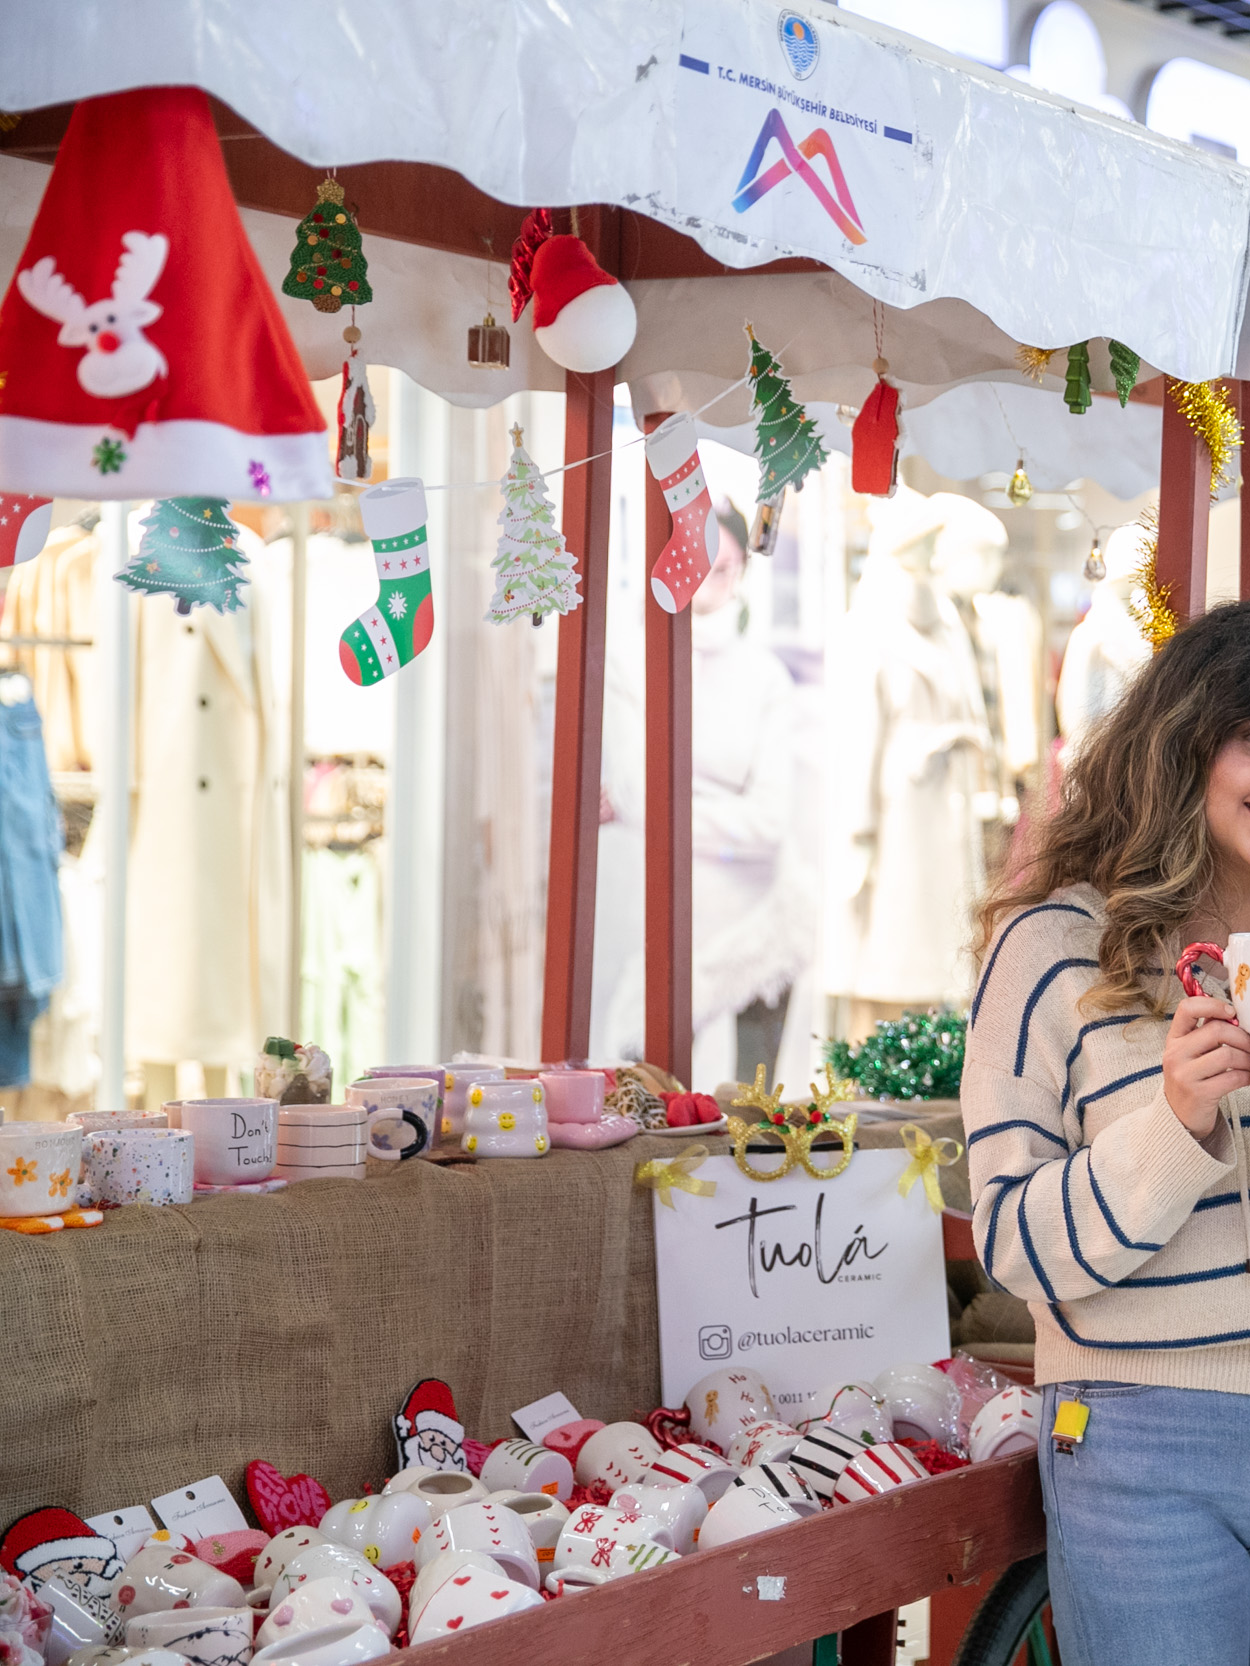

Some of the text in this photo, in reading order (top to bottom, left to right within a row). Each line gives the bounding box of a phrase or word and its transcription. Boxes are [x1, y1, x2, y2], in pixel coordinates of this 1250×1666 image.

[718, 66, 878, 134] T.C. MERSİN BÜYÜKŞEHİR BELEDİYESİ
[231, 1112, 269, 1139] Don't
[228, 1145, 273, 1166] Touch!
[837, 1273, 882, 1283] CERAMIC
[737, 1323, 875, 1351] @tuolaceramic
[778, 1393, 803, 1404] 0011
